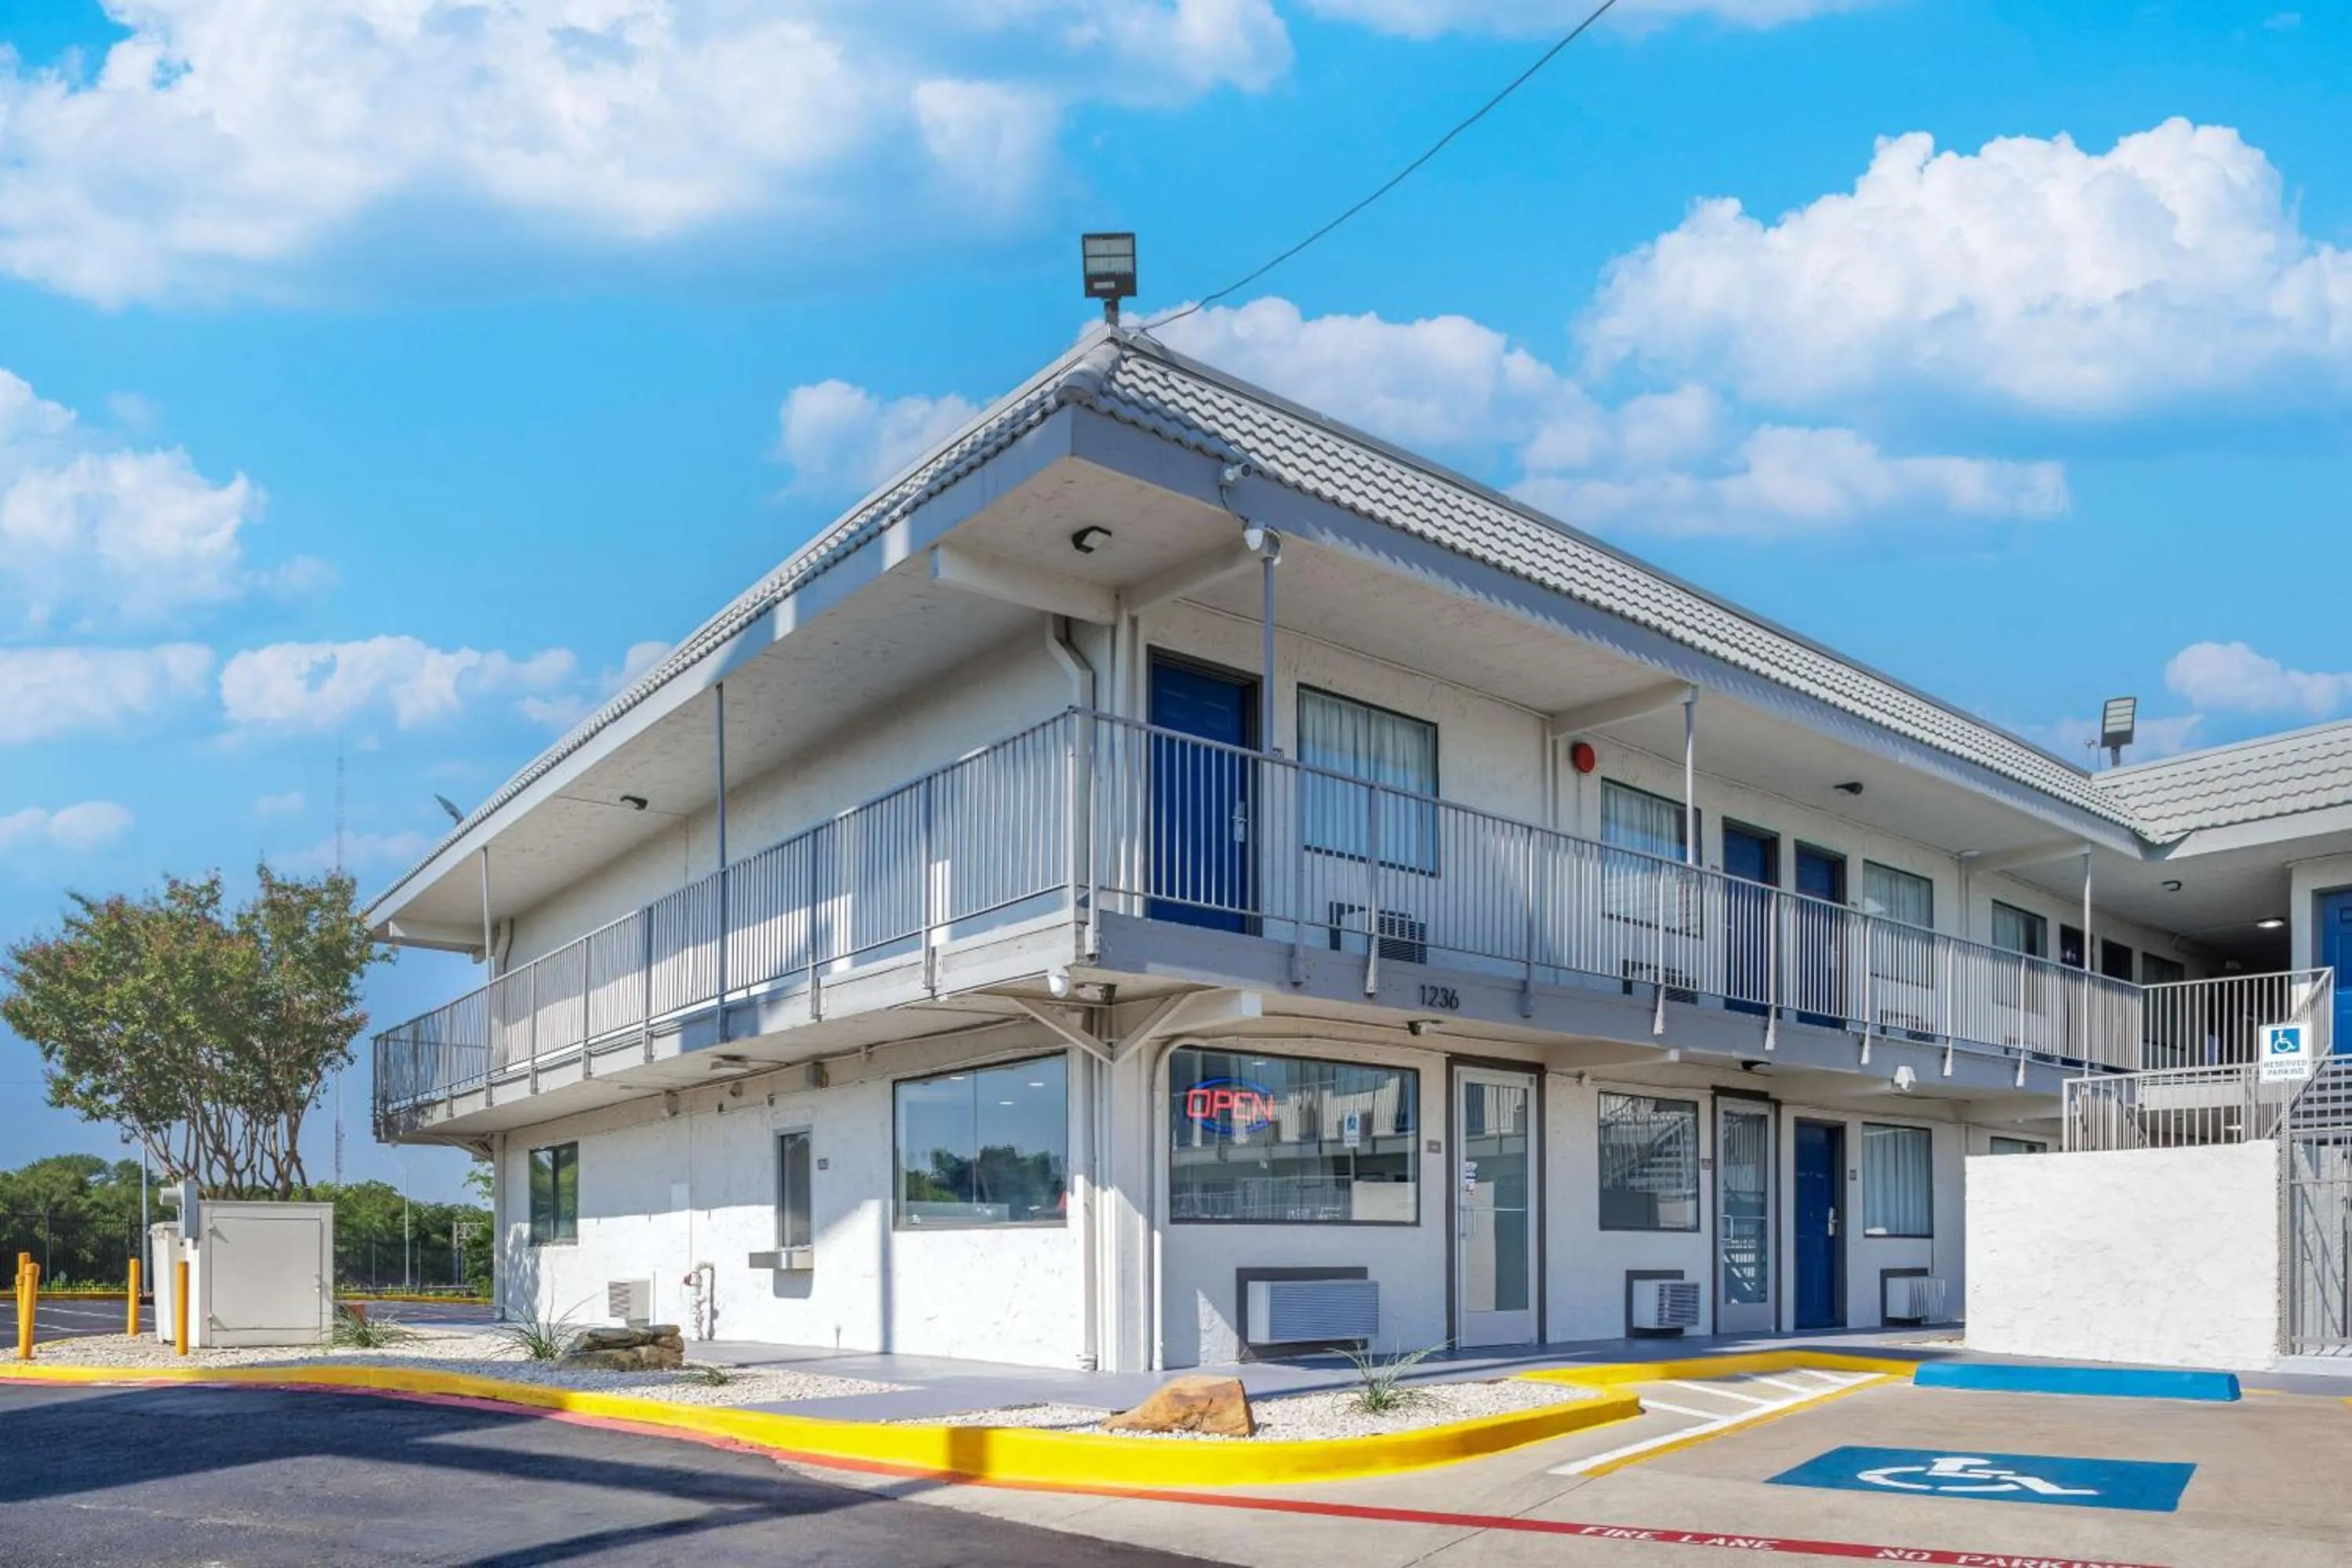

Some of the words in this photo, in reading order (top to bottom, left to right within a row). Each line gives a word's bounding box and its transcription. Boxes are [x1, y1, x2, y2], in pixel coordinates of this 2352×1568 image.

[1419, 983, 1459, 1010] 1236
[2263, 1059, 2307, 1068] RESERVED
[1187, 1088, 1275, 1123] OPEN
[1580, 1526, 1663, 1541] FIRE
[1680, 1534, 1780, 1549] LANE
[1876, 1548, 1932, 1562] NO
